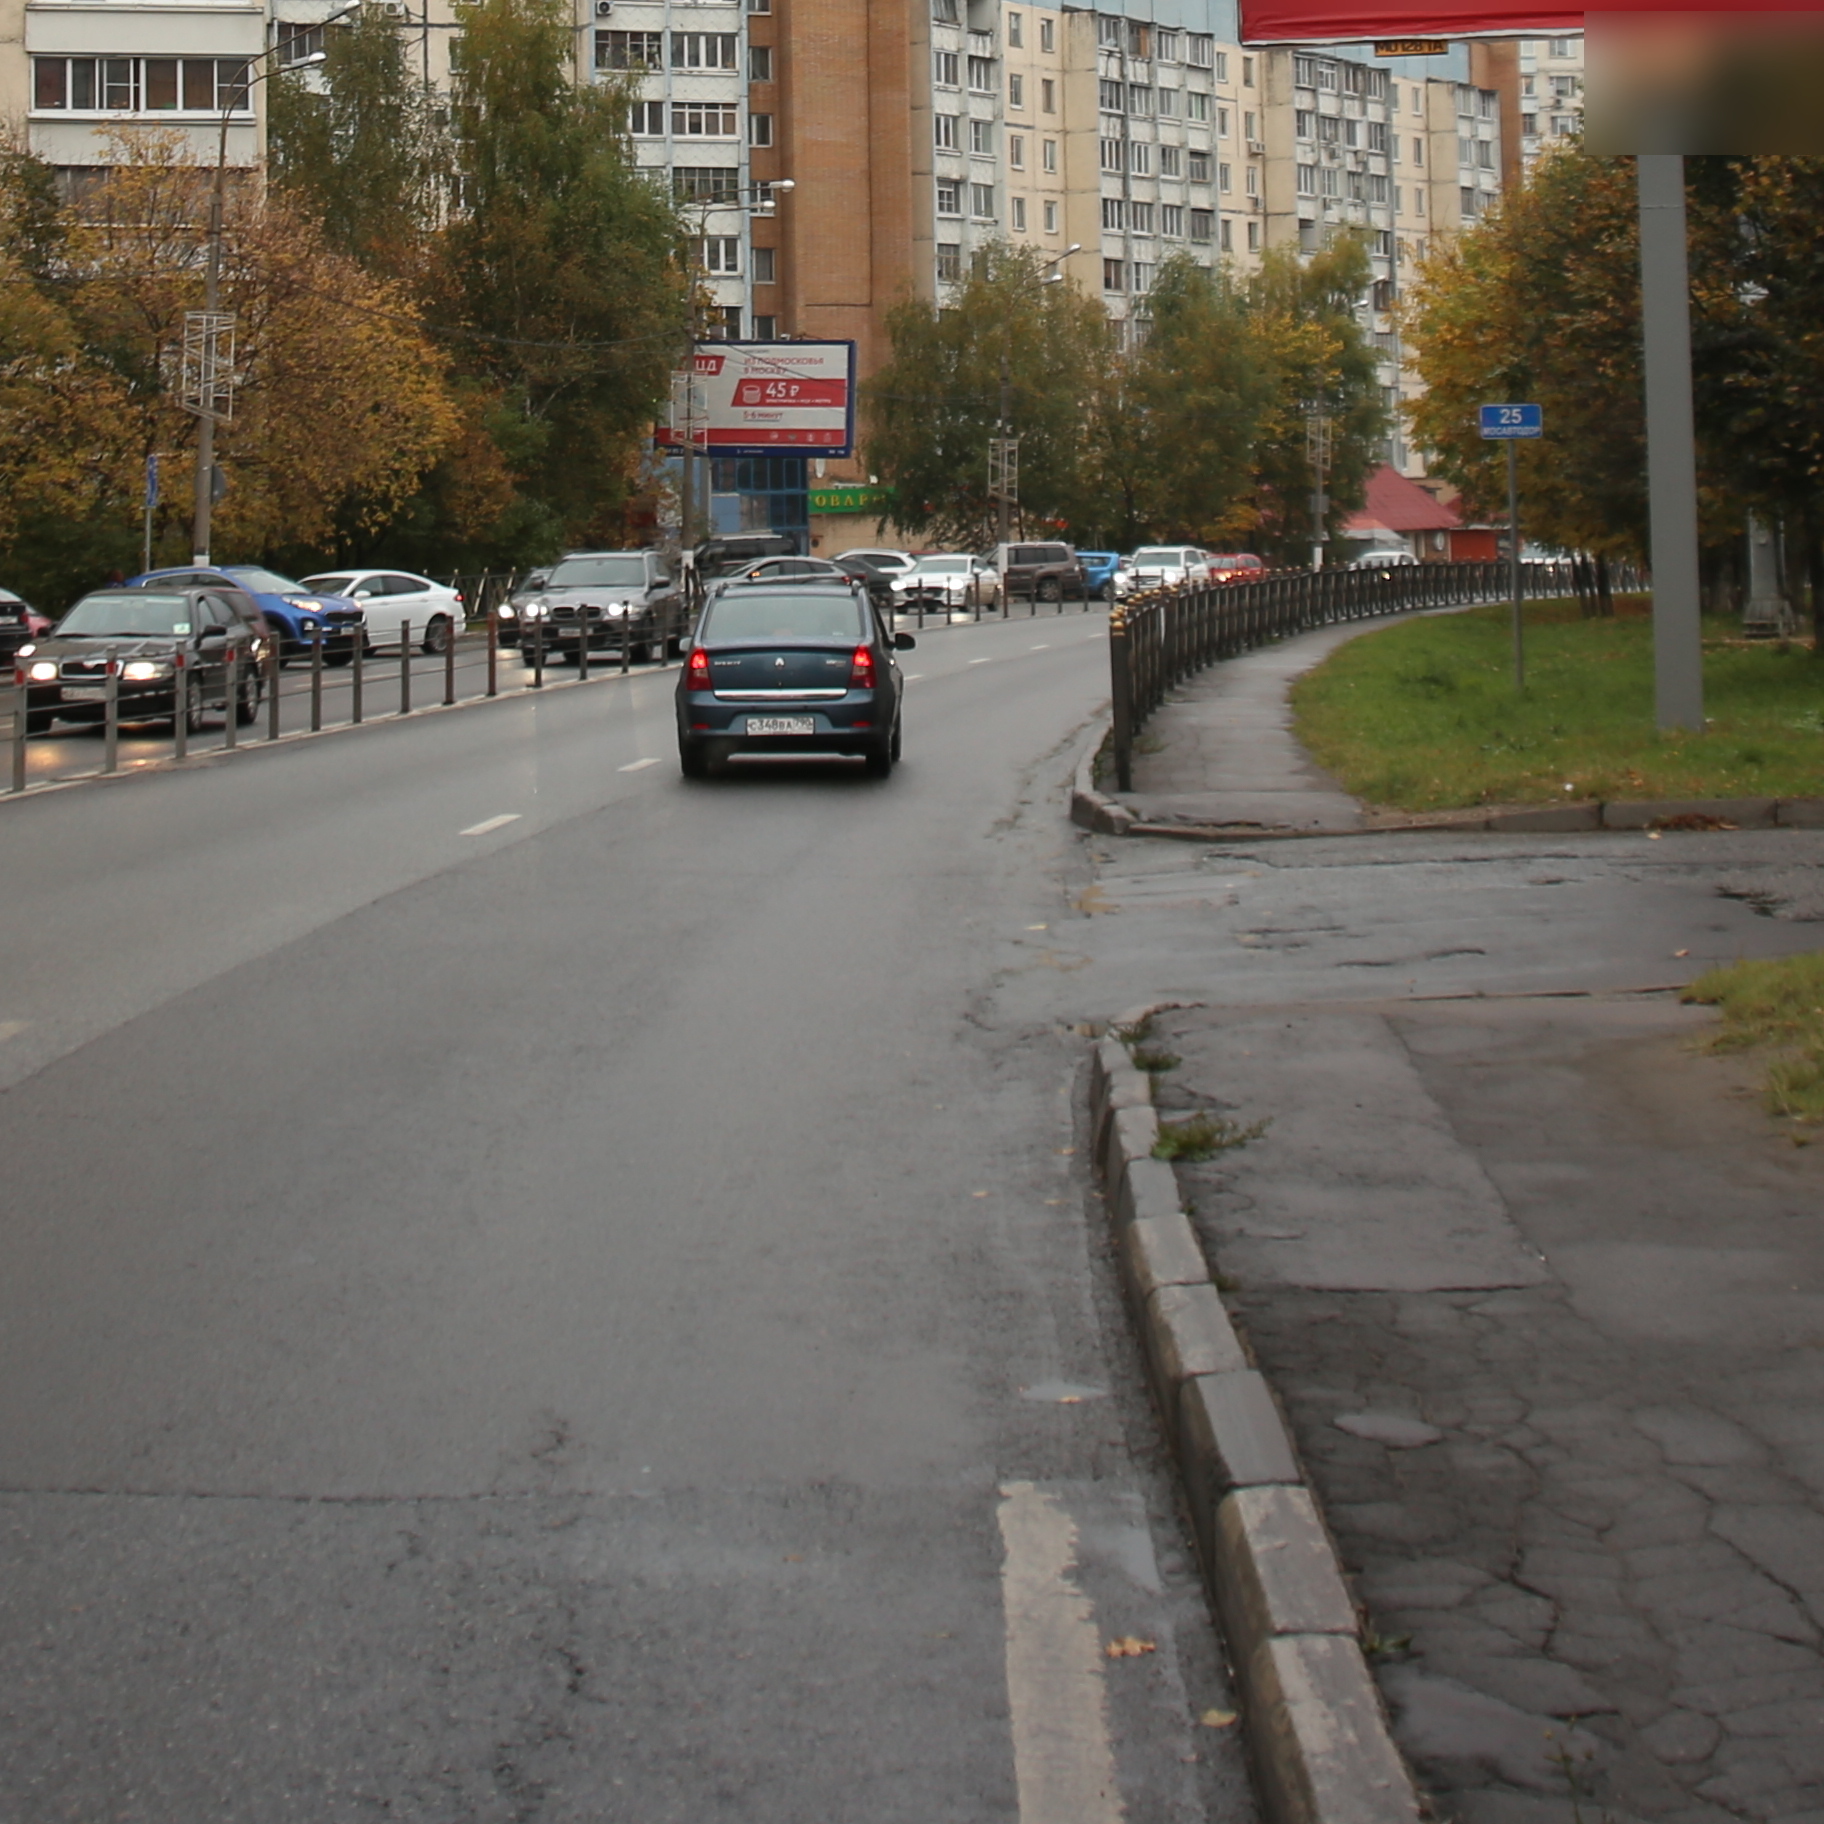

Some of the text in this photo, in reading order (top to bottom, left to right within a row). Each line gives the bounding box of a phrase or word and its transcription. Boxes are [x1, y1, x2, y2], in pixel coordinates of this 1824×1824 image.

[766, 382, 787, 398] 45
[1499, 408, 1523, 424] 25
[807, 494, 887, 507] ОВАР
